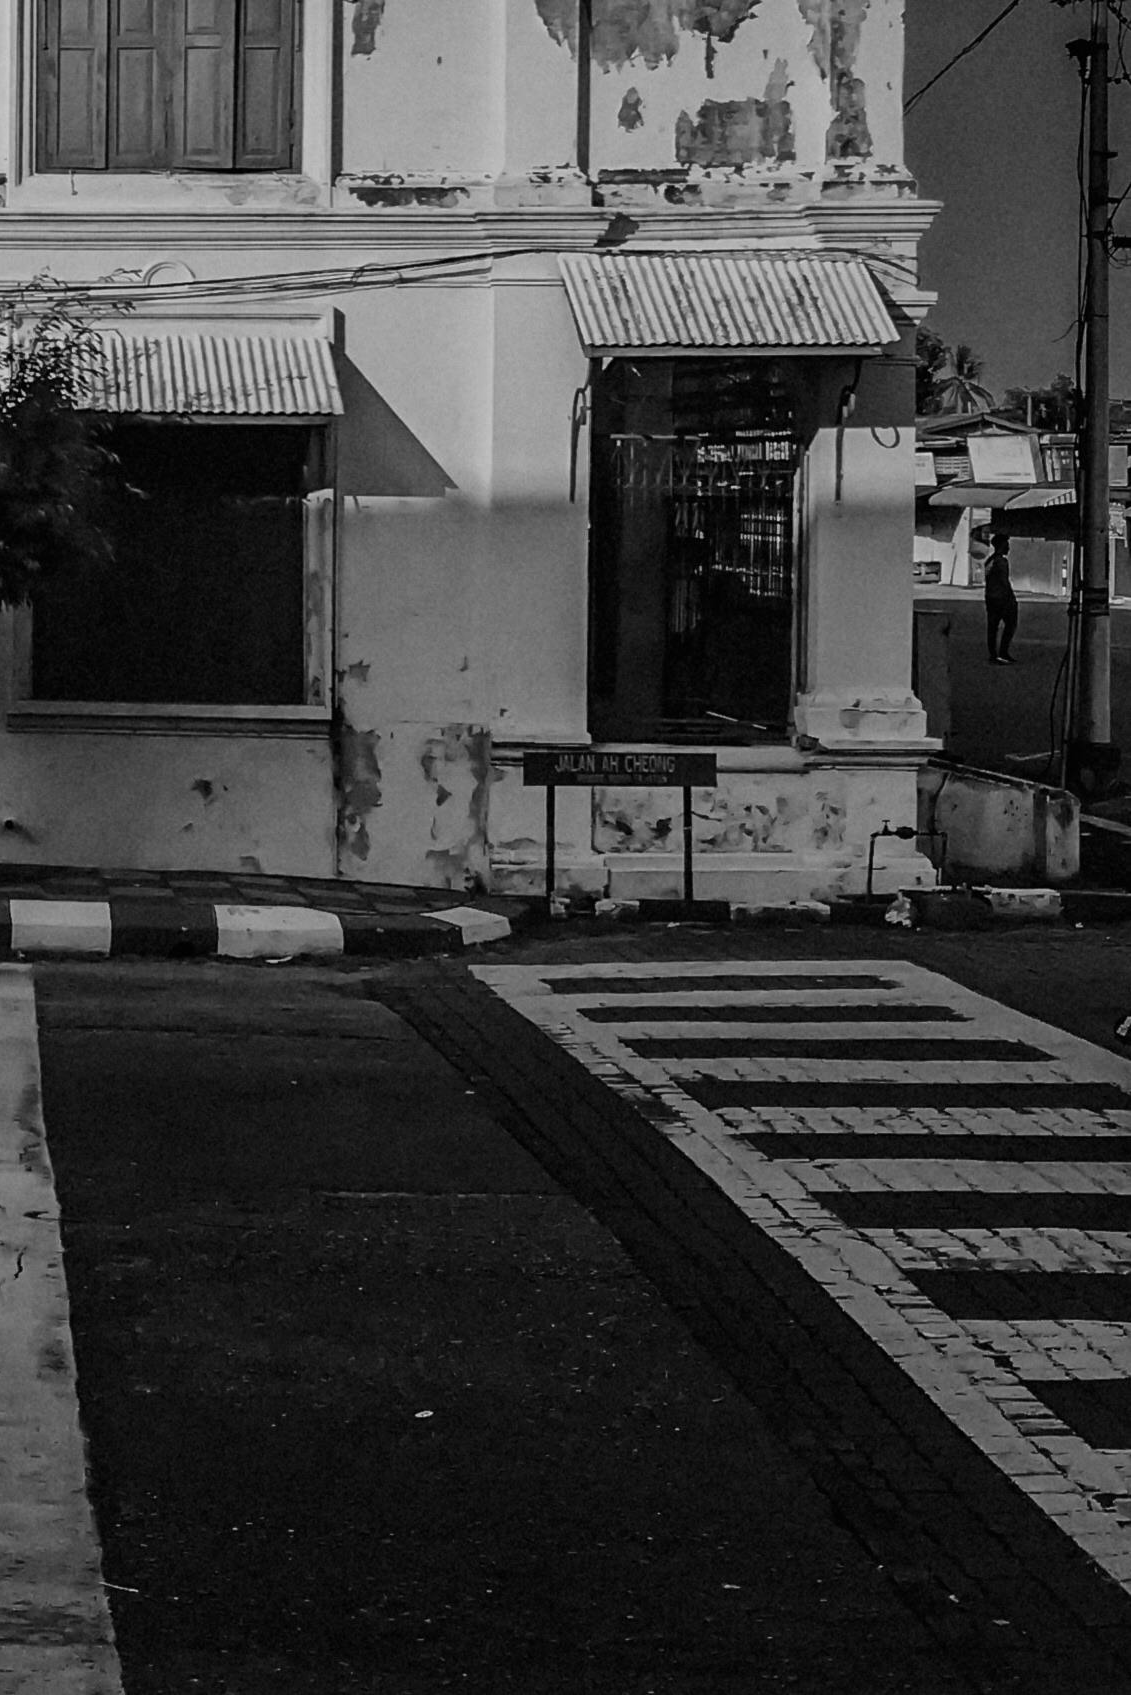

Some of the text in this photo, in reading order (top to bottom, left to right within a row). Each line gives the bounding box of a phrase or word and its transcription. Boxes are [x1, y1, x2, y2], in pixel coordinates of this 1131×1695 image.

[555, 755, 675, 772] JALAN AH CHEONG
